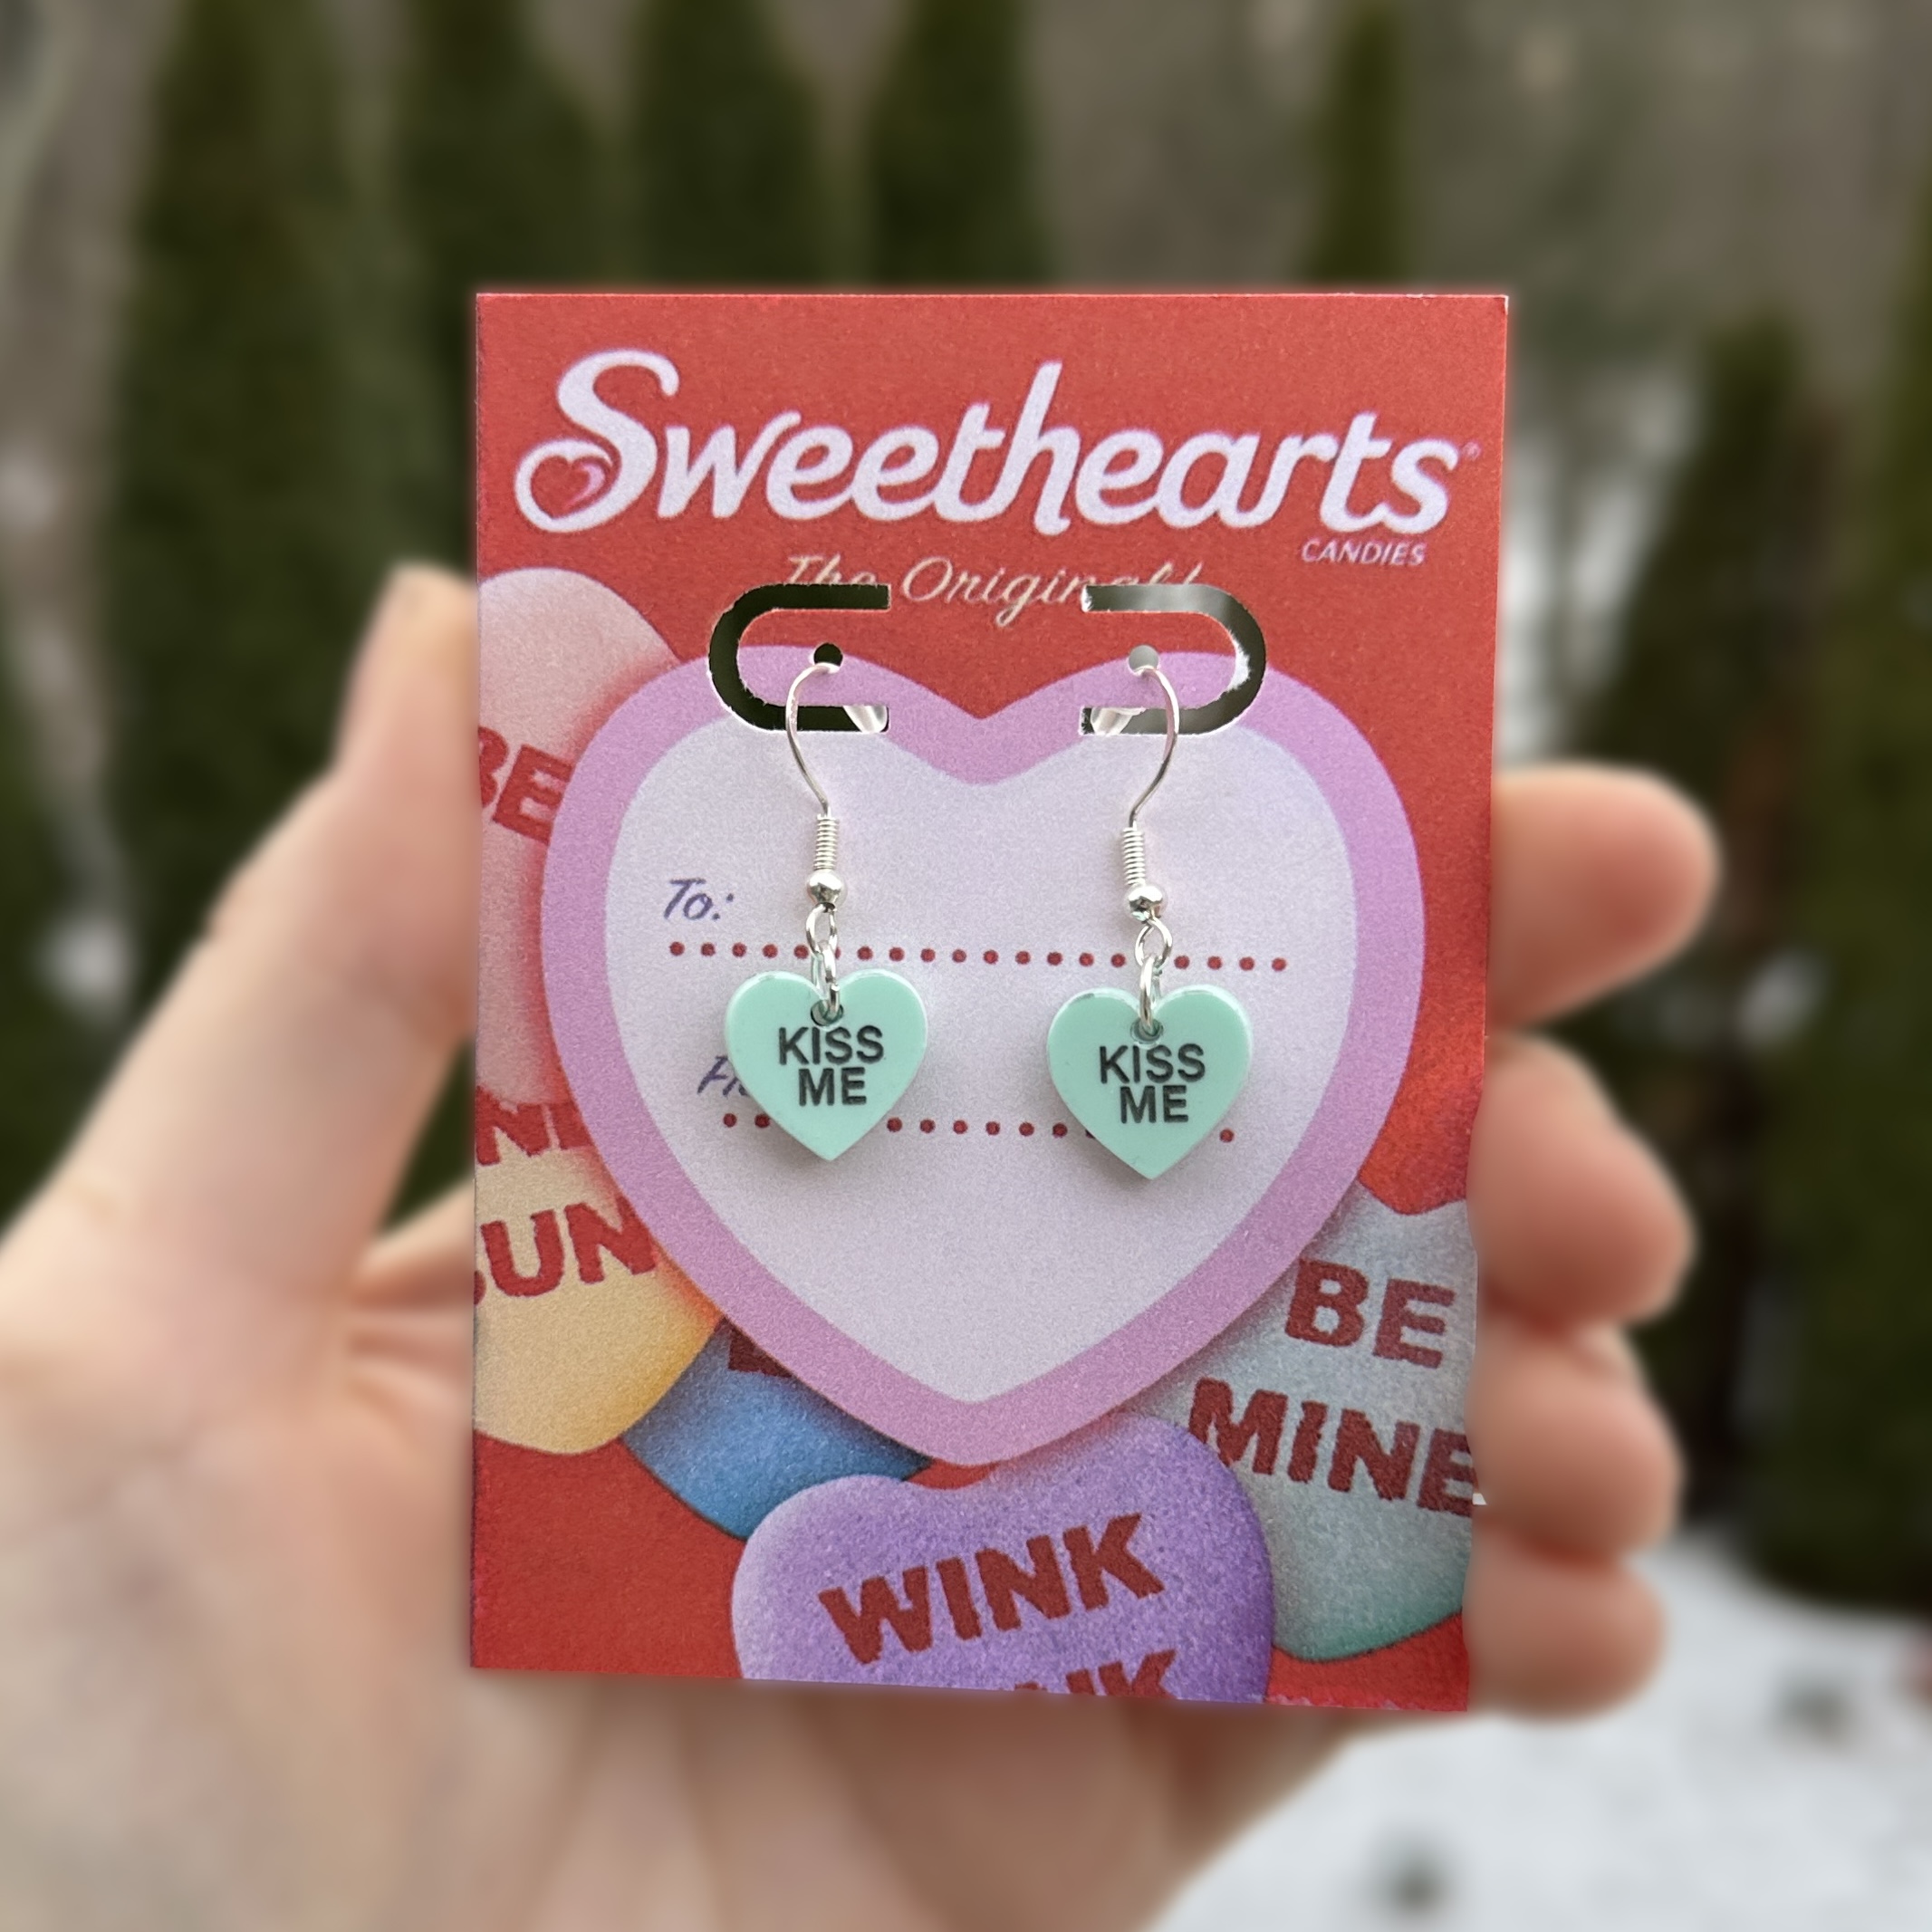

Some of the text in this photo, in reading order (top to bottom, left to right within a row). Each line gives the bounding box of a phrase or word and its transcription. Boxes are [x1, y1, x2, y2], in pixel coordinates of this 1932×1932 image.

[514, 349, 1458, 536] Sweethearts
[1301, 538, 1427, 566] CANDIES
[663, 877, 735, 920] To:
[779, 1024, 884, 1065] KISS
[1099, 1043, 1206, 1084] KISS
[798, 1066, 867, 1106] ME
[1120, 1084, 1189, 1124] ME
[474, 1197, 657, 1305] UN
[1284, 1258, 1456, 1369] BE
[1187, 1377, 1478, 1517] MINE
[818, 1512, 1165, 1665] WINK
